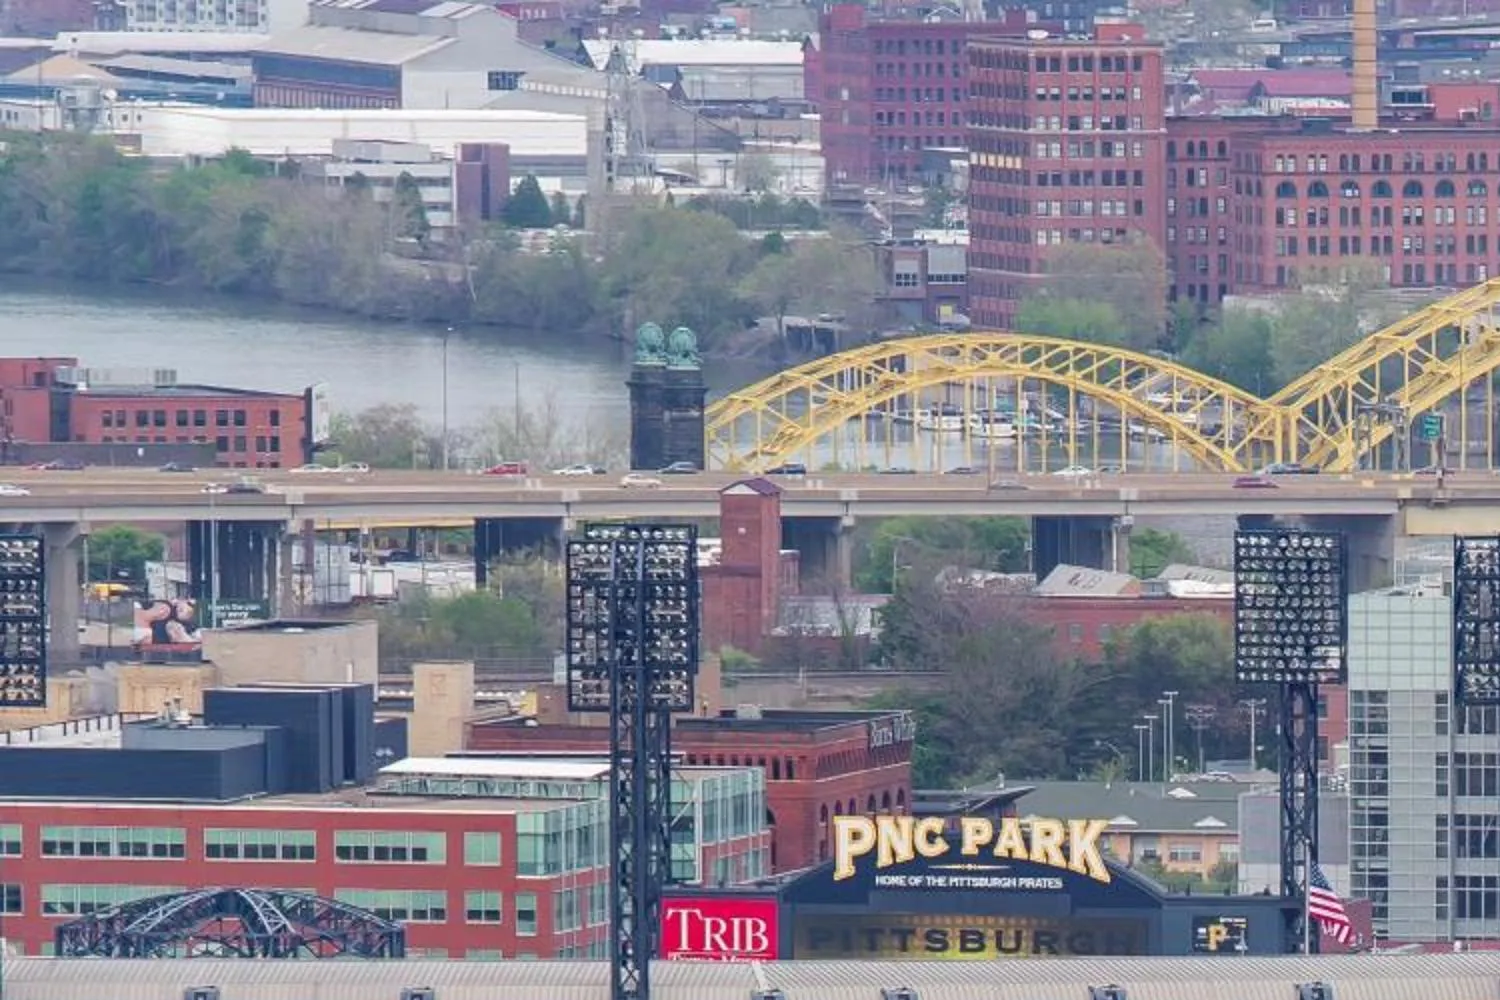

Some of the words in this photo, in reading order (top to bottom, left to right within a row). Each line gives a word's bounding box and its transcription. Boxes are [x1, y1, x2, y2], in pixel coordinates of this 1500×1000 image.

[833, 815, 949, 881] PNC
[961, 816, 1111, 884] PARK
[875, 875, 907, 886] HOME
[908, 875, 925, 886] OF
[926, 876, 947, 887] THE
[948, 876, 1017, 888] PITTSBURGH
[1018, 877, 1063, 889] PIRATES
[666, 908, 769, 953] TRIB
